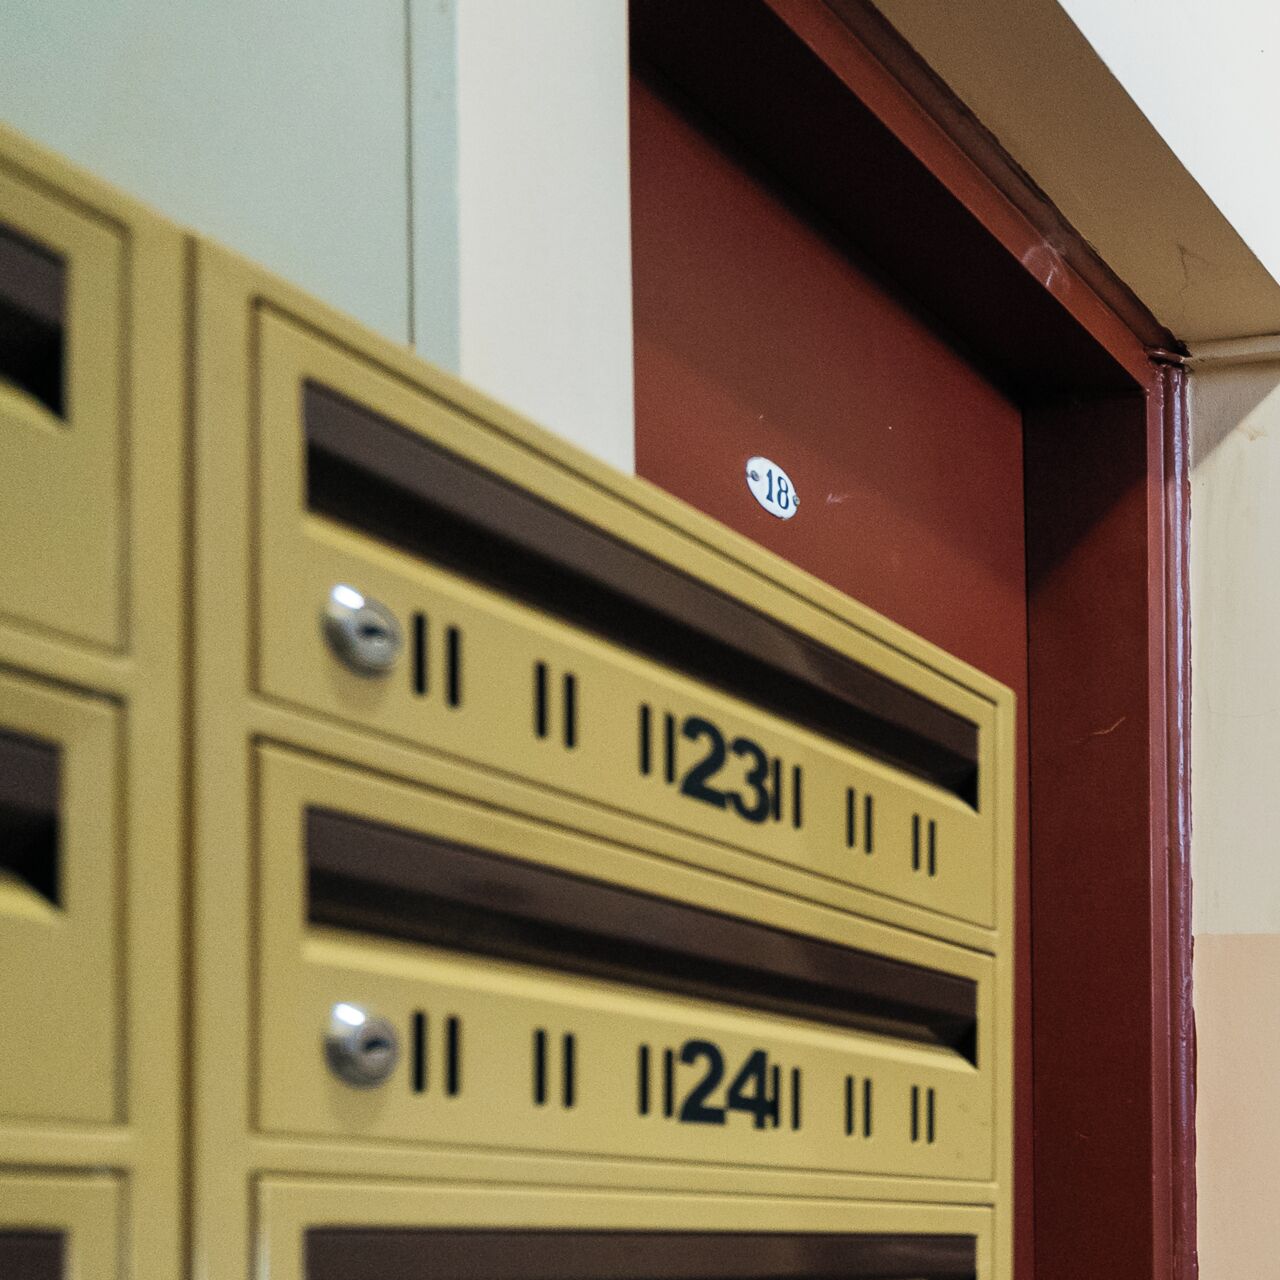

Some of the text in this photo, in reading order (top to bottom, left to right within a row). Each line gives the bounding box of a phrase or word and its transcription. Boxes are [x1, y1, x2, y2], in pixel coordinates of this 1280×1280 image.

[766, 469, 790, 510] 18
[680, 716, 771, 825] 23
[678, 1039, 773, 1130] 24
